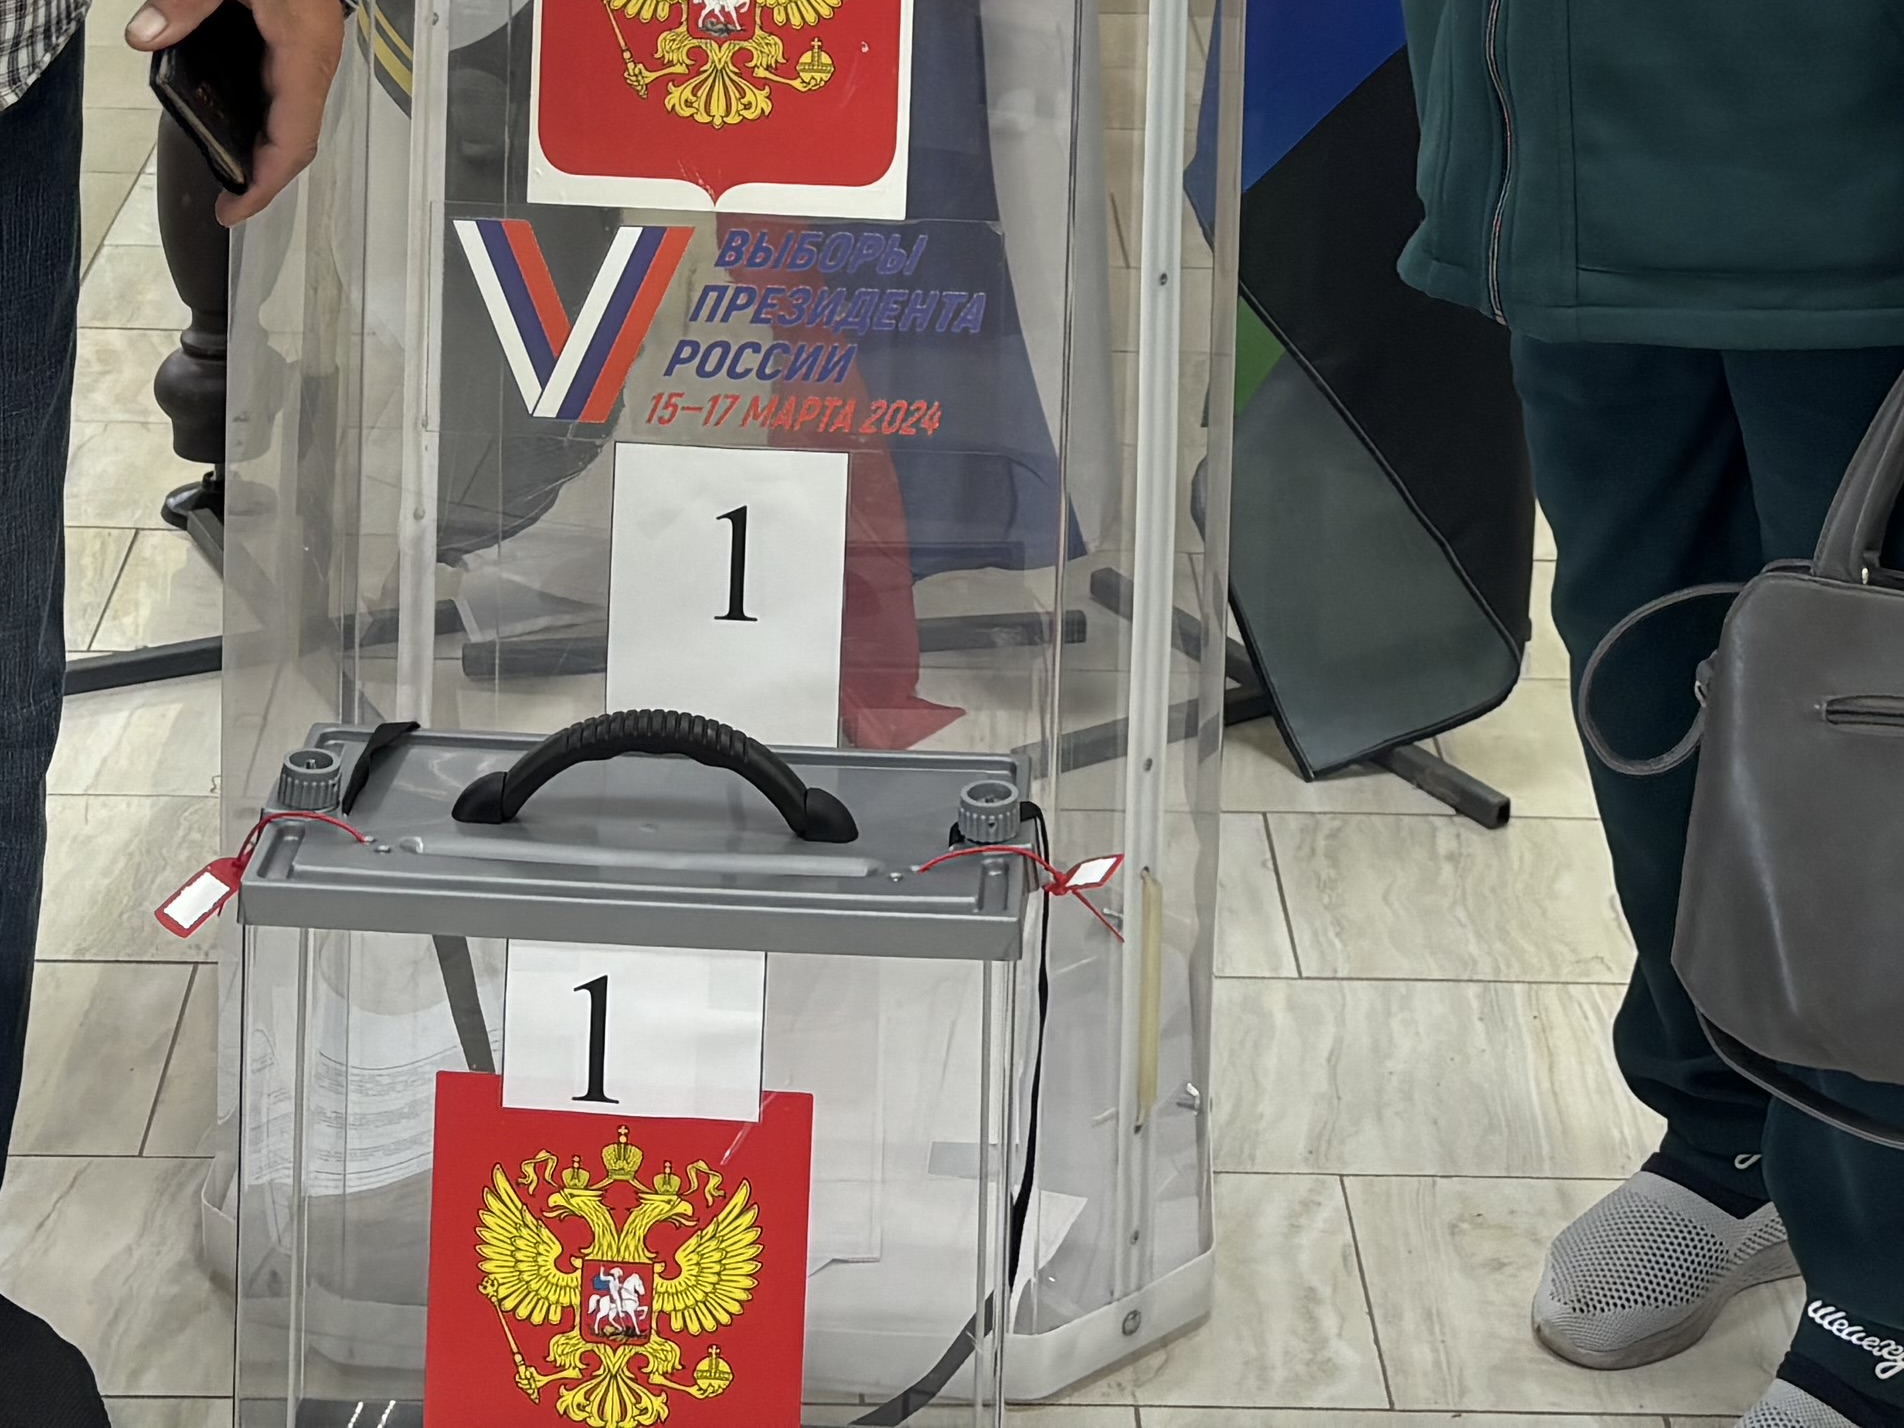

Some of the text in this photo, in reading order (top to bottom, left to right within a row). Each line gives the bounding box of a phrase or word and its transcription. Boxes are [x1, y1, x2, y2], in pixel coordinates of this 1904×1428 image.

[714, 228, 929, 275] ВЫБОРЫ
[688, 284, 987, 336] ПРЕЗИДЕНТА
[663, 339, 859, 384] РОССИИ
[739, 395, 856, 433] МАРТА
[858, 399, 942, 435] 2024
[715, 505, 758, 623] 1
[572, 973, 620, 1106] 1
